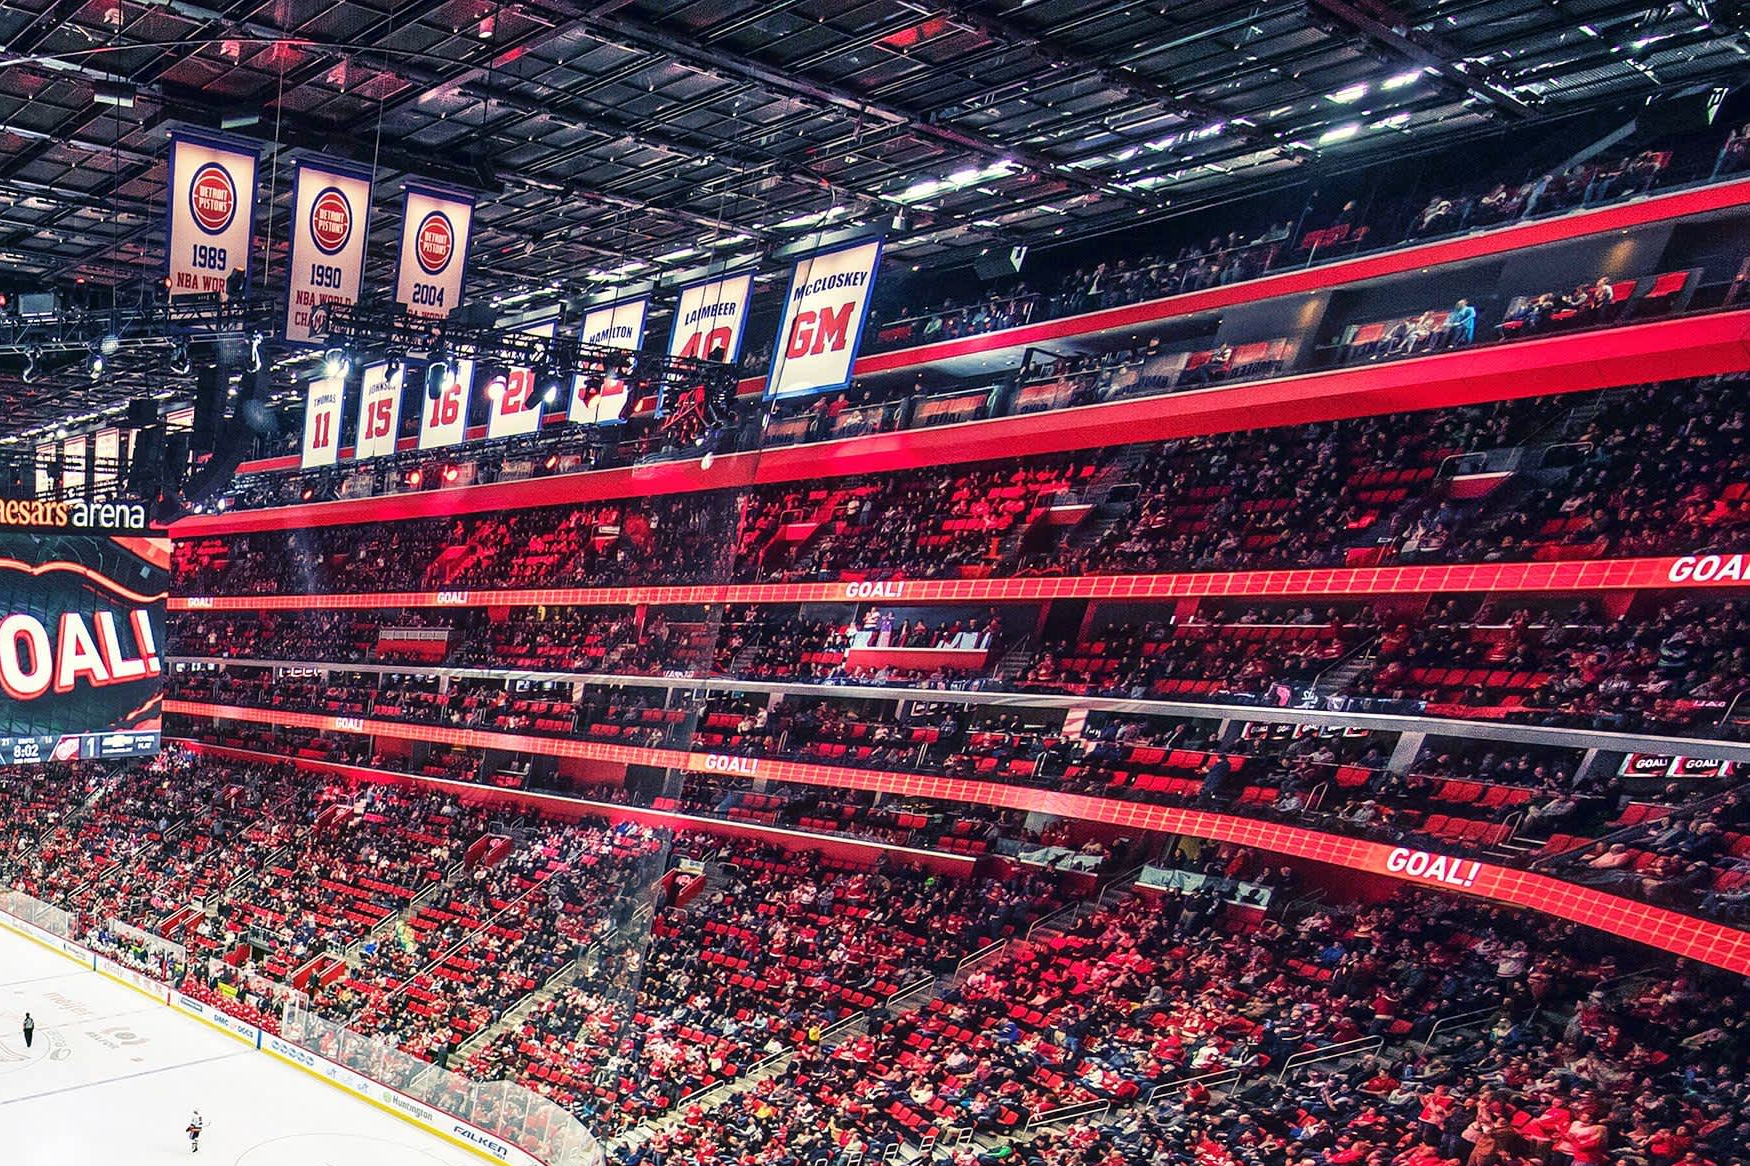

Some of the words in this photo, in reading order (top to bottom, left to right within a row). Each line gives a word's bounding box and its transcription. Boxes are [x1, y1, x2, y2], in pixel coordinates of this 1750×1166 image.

[200, 185, 229, 201] DETROIT
[199, 198, 228, 213] PISTONS
[319, 208, 346, 224] DETROIT
[318, 220, 344, 235] PISTONS
[424, 231, 447, 245] DETROIT
[192, 244, 226, 271] 1989
[423, 241, 447, 255] PISTONS
[177, 272, 199, 291] NBA
[310, 263, 342, 289] 1990
[794, 270, 868, 301] McCLOSKEY
[295, 290, 316, 306] NBA
[412, 283, 445, 307] 2004
[684, 302, 737, 326] LAIMBEER
[589, 326, 633, 345] HAMILTON
[786, 301, 856, 360] GM
[313, 393, 336, 408] THOMAS
[429, 383, 461, 428] 16
[365, 398, 393, 440] 15
[313, 411, 331, 449] 11
[73, 502, 146, 529] arena
[1668, 554, 1750, 582] GOA
[437, 591, 468, 604] GOAL!
[845, 581, 906, 599] GOAL!
[188, 597, 214, 608] GOAL!
[335, 718, 364, 731] GOAL!
[13, 744, 39, 758] 8:02
[86, 737, 96, 757] 1
[704, 754, 760, 775] GOAL!
[1636, 758, 1668, 769] GOAL!
[1685, 759, 1719, 770] GOAL!
[1386, 847, 1483, 887] GOAL!
[213, 1014, 229, 1026] DMC
[393, 1095, 433, 1121] Huntington
[453, 1125, 508, 1156] FALKEN
